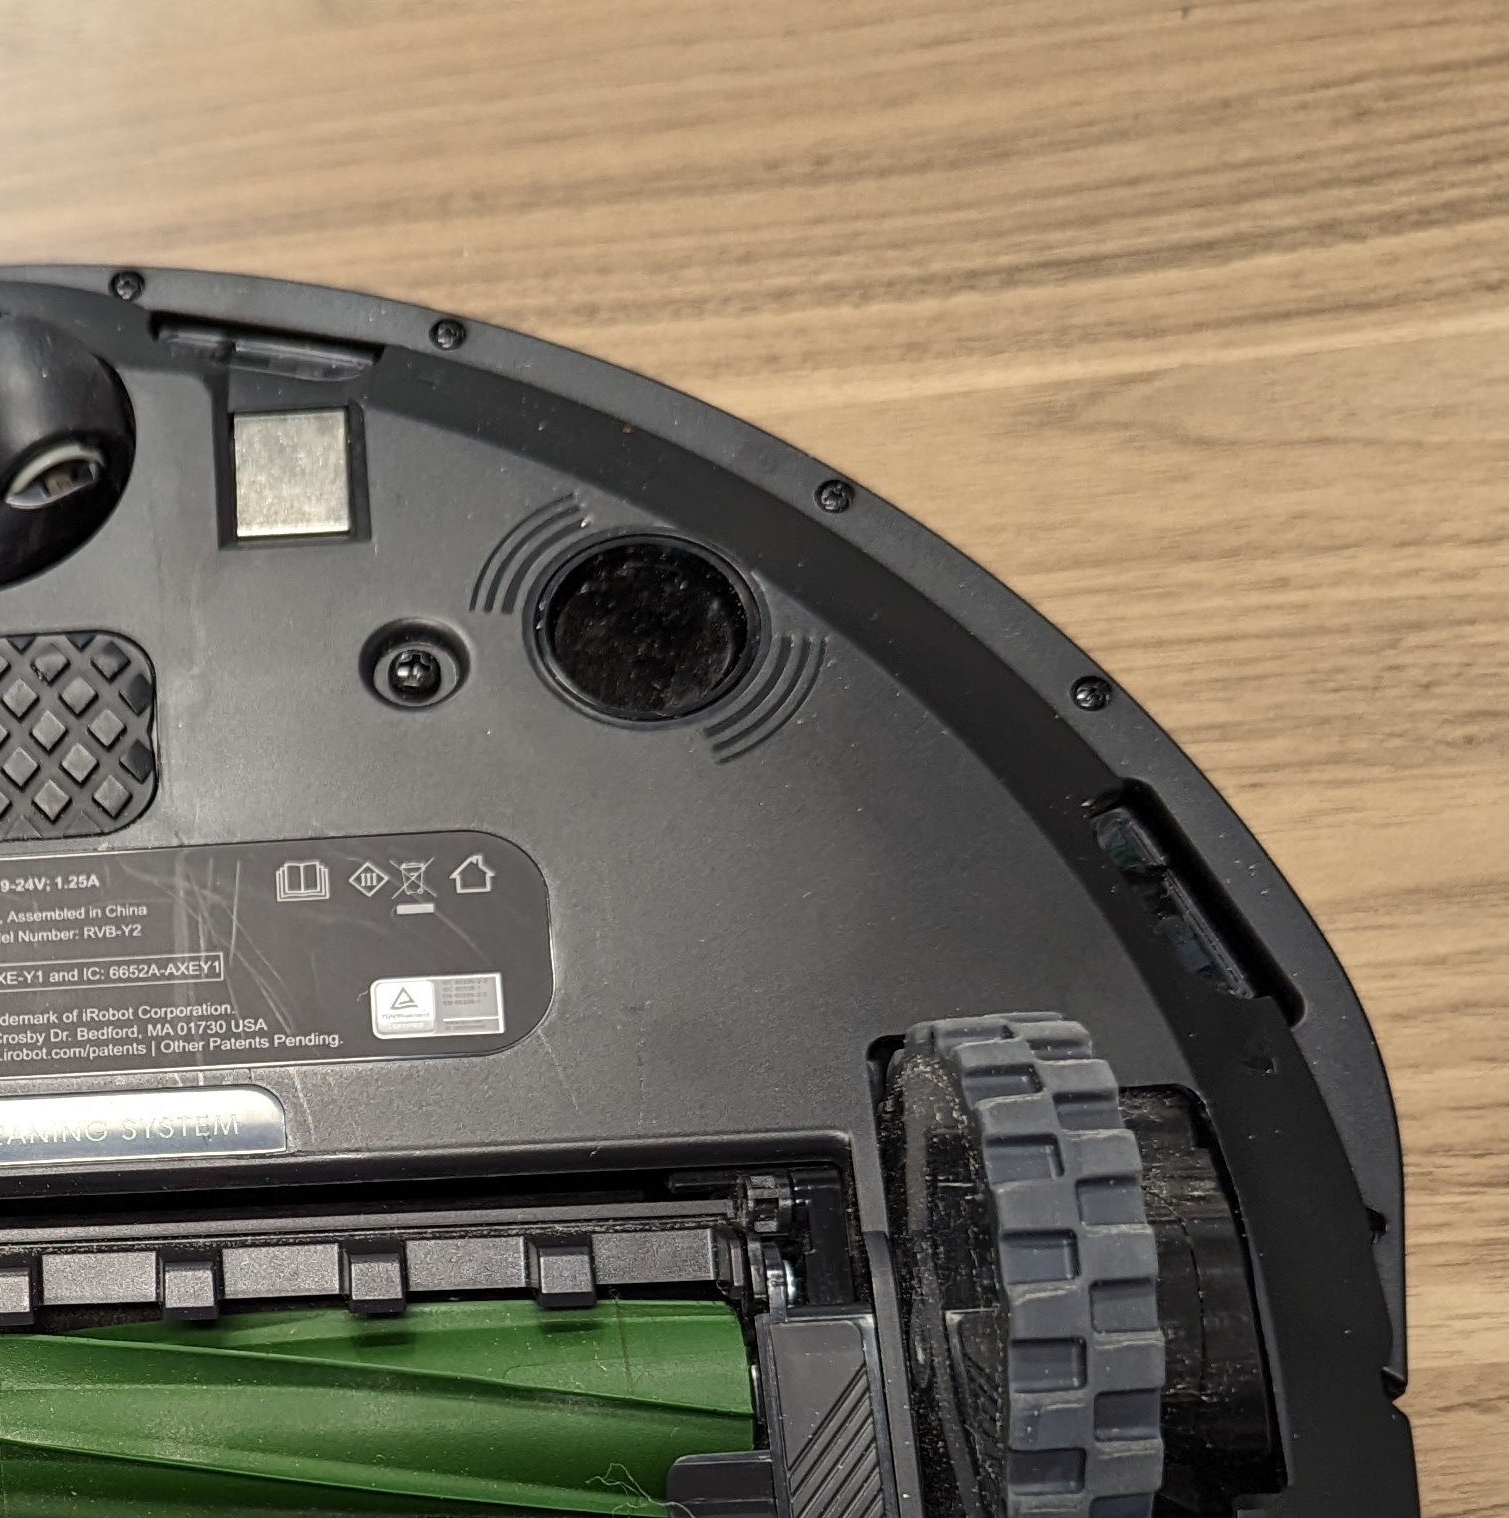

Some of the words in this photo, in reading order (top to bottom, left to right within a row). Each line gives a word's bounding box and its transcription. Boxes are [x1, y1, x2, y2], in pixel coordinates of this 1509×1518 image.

[54, 874, 100, 890] 1.25A
[7, 906, 85, 923] Assembled
[89, 906, 102, 918] in
[105, 904, 148, 918] China
[18, 928, 79, 943] Number:
[84, 924, 142, 939] RVB-Y2
[49, 968, 78, 983] and
[83, 967, 105, 981] IC:
[109, 960, 220, 980] 6652A-AXEY1
[62, 1008, 79, 1023] of
[82, 1006, 134, 1022] iRobot
[138, 1002, 236, 1020] Corporation.
[50, 1028, 72, 1042] Dr.
[76, 1024, 142, 1041] Bedford,
[147, 1023, 174, 1037] MA
[177, 1019, 226, 1036] 01730
[231, 1018, 268, 1033] USA
[160, 1038, 205, 1053] Other
[209, 1036, 269, 1051] Patents
[273, 1032, 344, 1048] Pending.
[121, 1113, 240, 1142] SYSTEM
